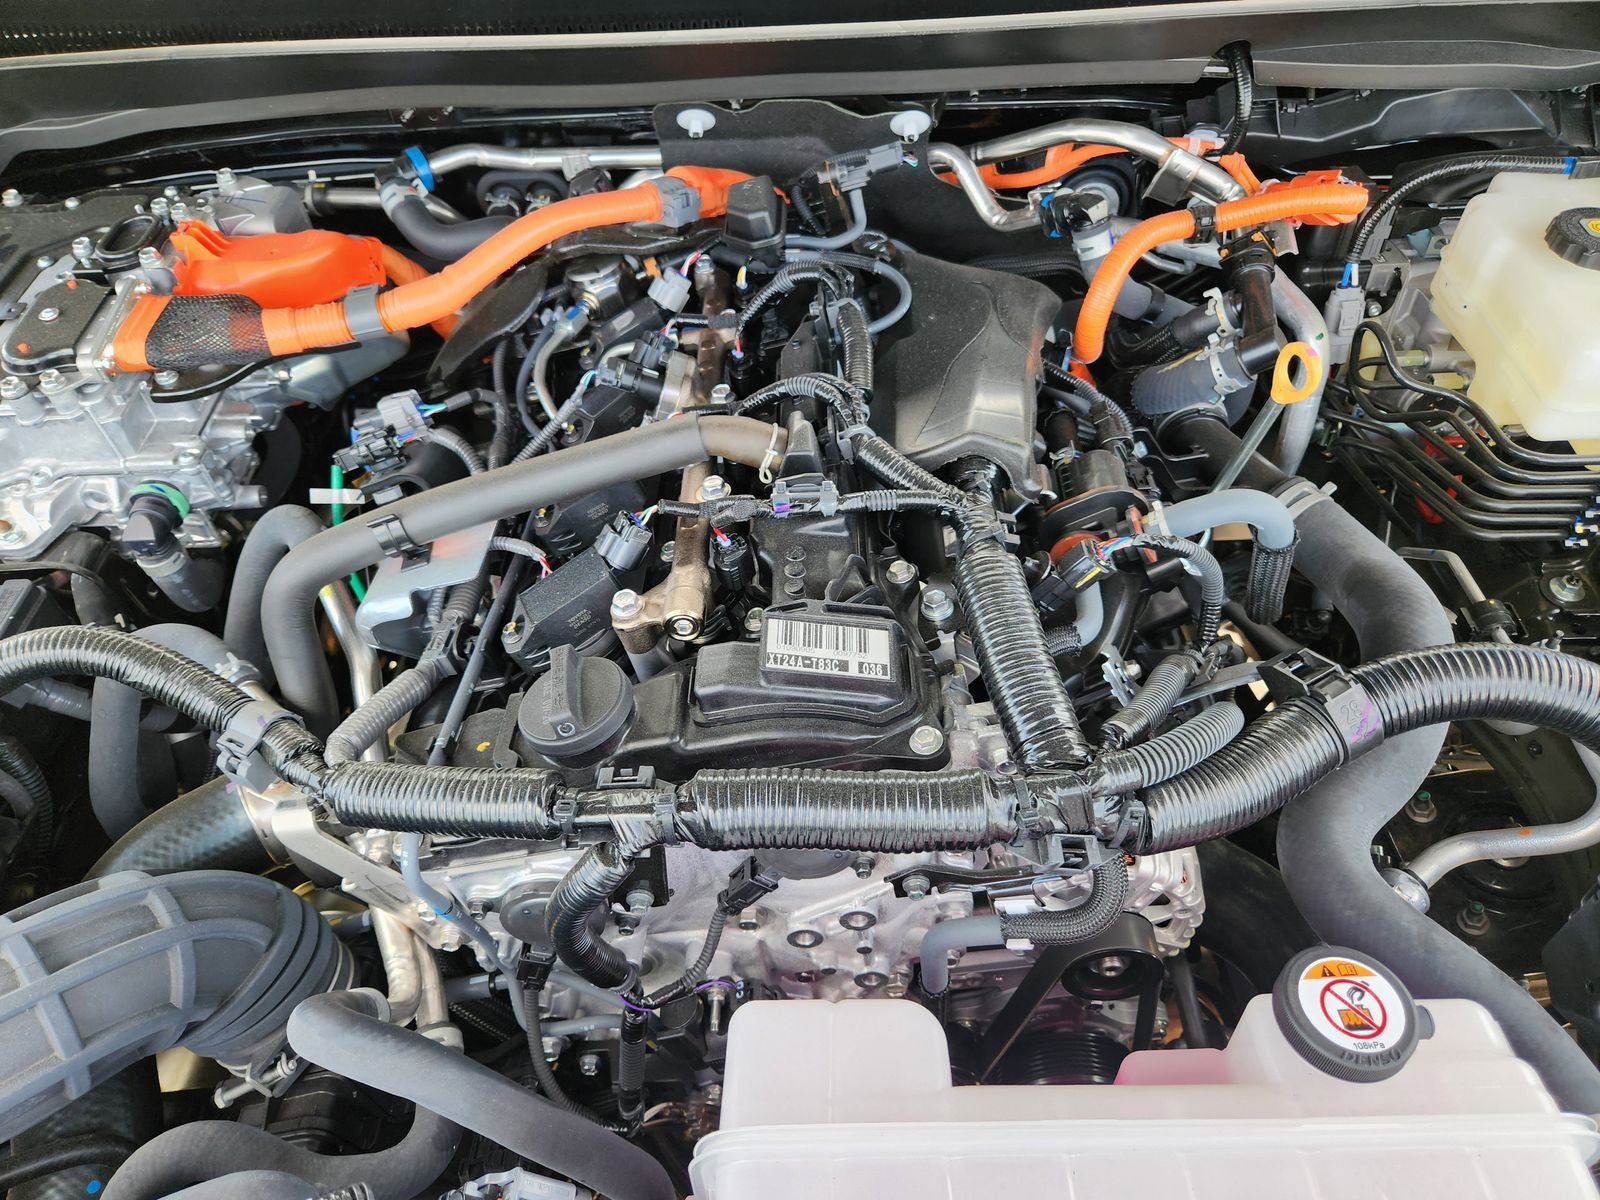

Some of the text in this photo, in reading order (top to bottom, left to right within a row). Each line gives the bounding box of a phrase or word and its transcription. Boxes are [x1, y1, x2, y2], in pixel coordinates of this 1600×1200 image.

[568, 609, 588, 623] TOYOTA
[768, 653, 883, 676] XT24A-T83C 036
[1352, 1041, 1386, 1050] 108kPa
[1341, 1049, 1401, 1066] DENSO
